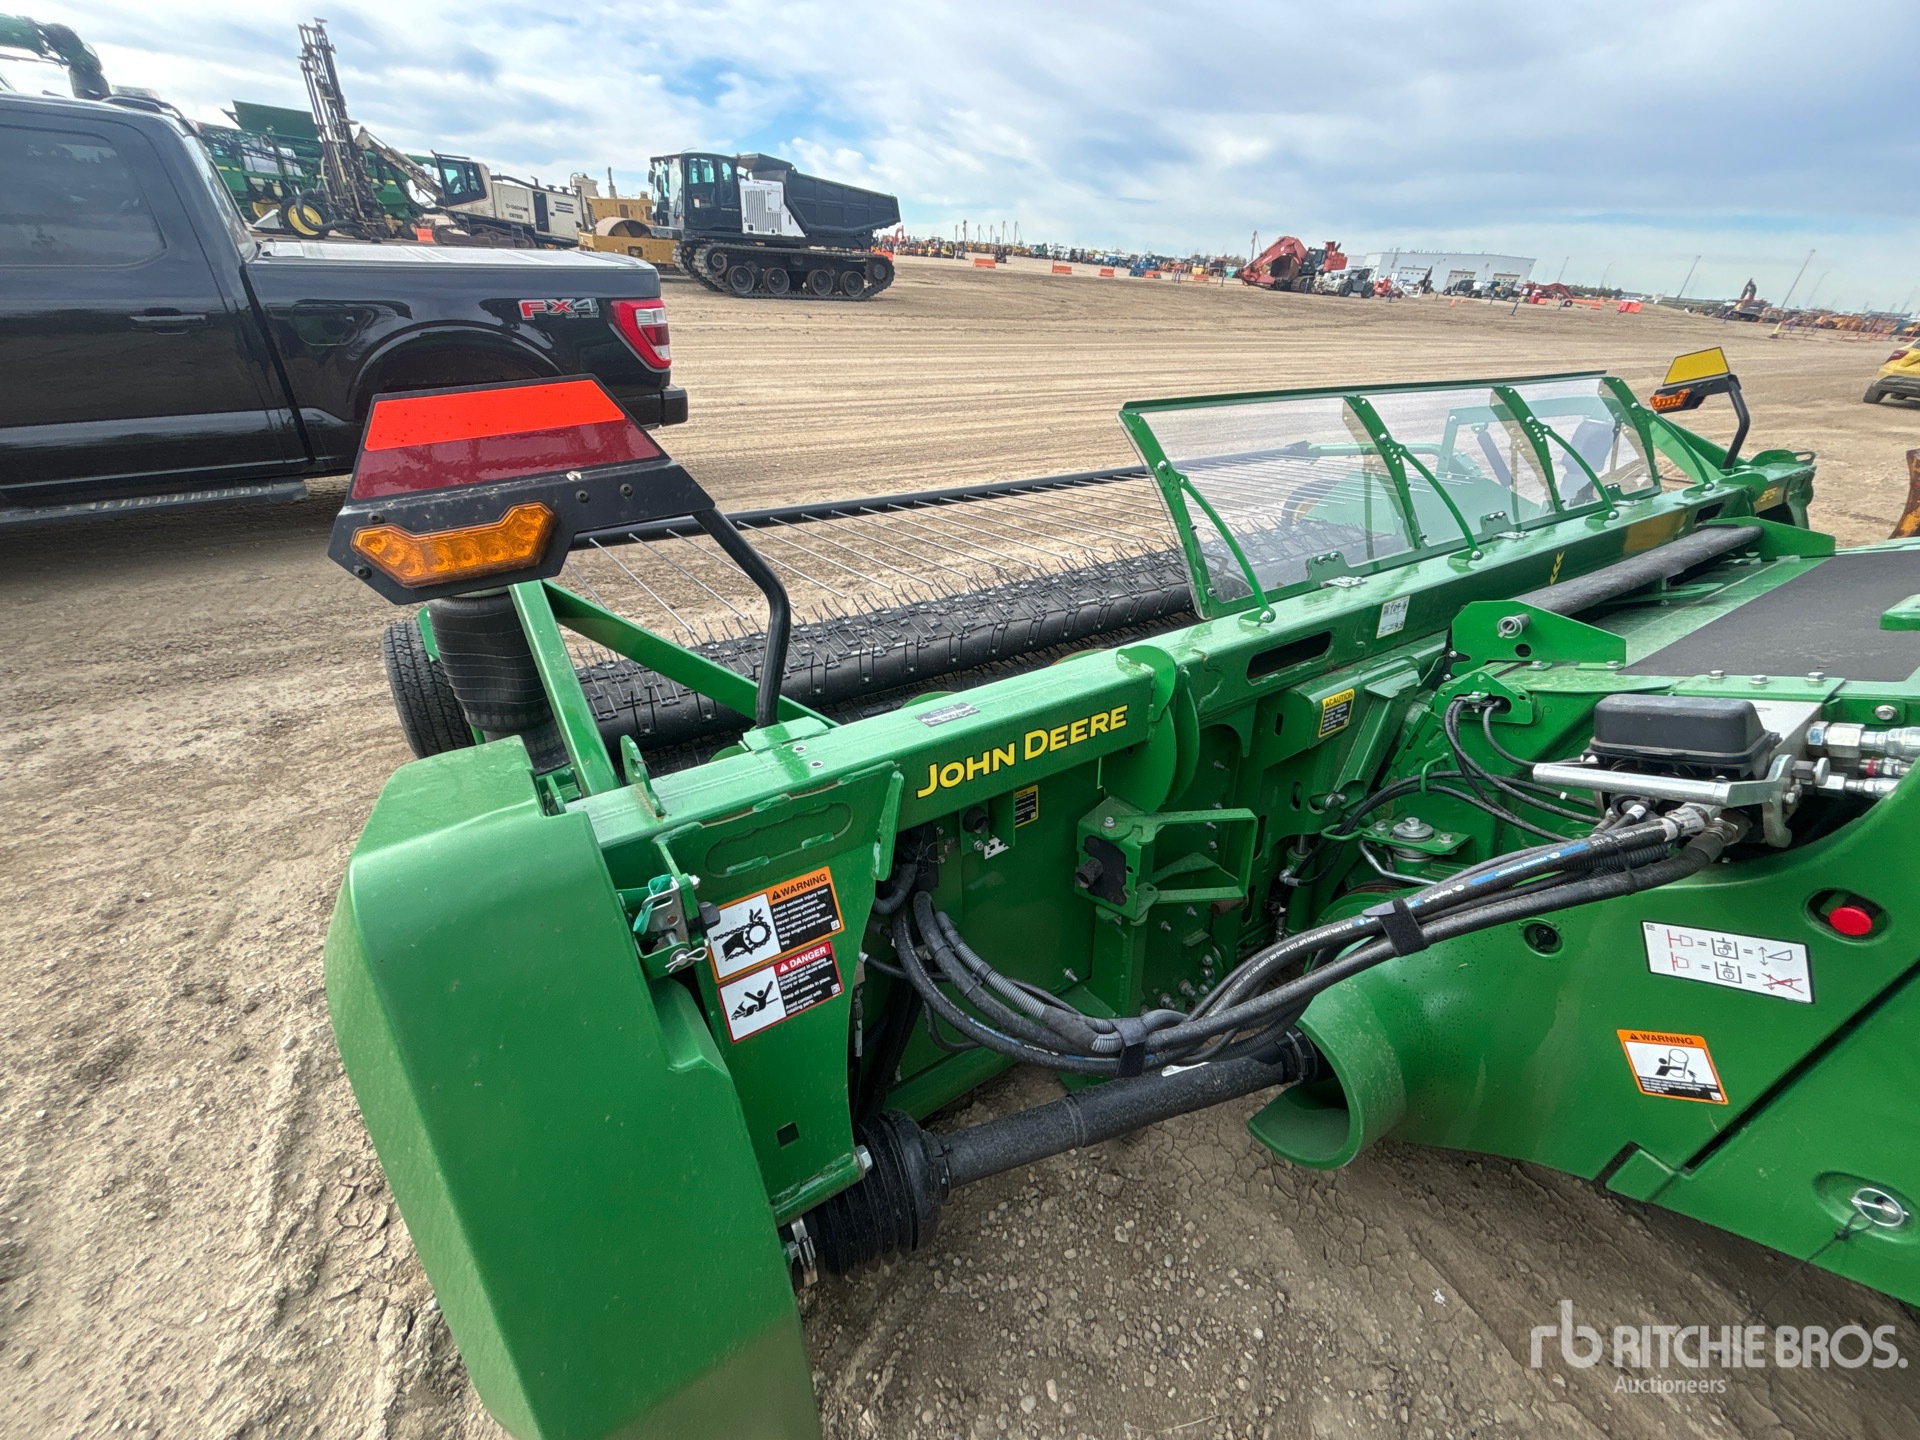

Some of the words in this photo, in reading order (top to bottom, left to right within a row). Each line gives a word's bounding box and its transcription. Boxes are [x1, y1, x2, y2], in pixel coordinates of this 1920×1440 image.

[518, 298, 600, 320] FX4
[1330, 691, 1353, 706] CAUTION
[916, 740, 1016, 799] JOHN
[1024, 704, 1129, 761] DEERE
[780, 874, 827, 896] WARNING
[789, 946, 826, 968] DANGER
[1640, 1034, 1694, 1045] WARNING
